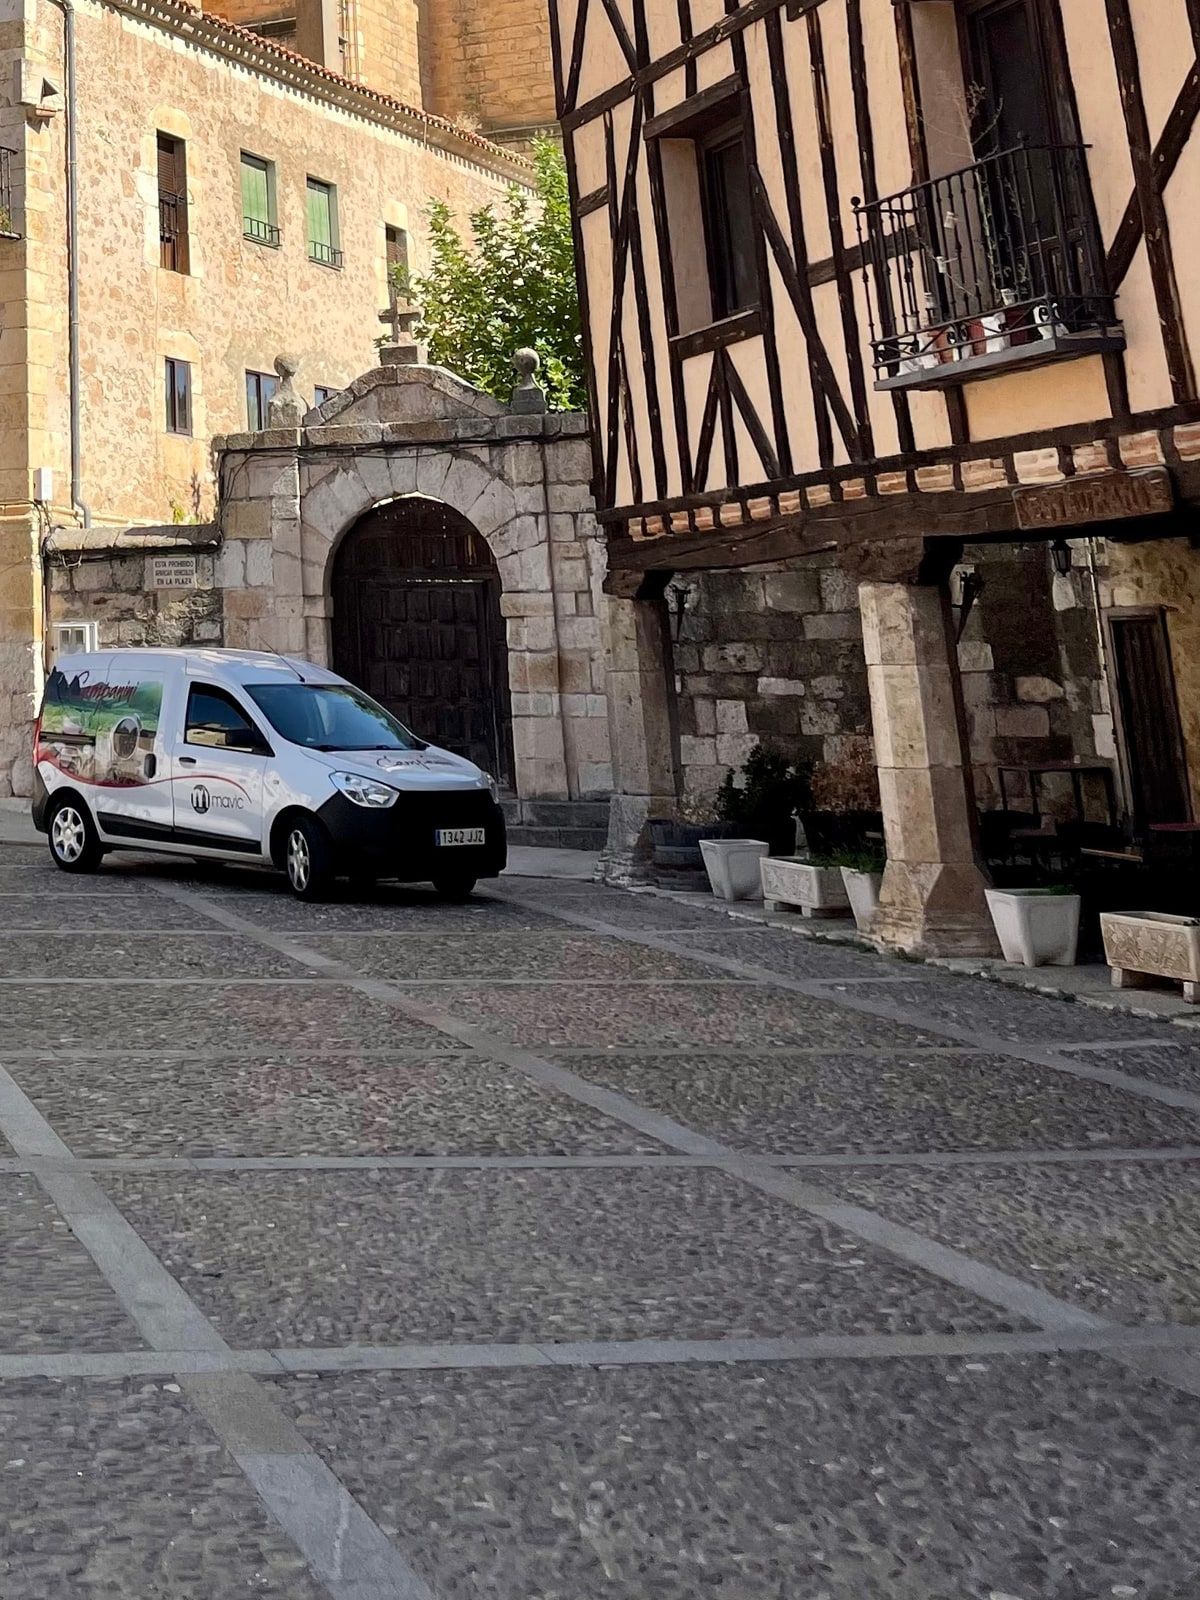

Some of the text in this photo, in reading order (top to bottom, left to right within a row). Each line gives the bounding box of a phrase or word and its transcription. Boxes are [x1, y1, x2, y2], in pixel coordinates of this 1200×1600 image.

[168, 560, 194, 568] PROHIBIDO
[175, 577, 192, 585] PLAZA
[211, 795, 244, 810] mavic
[443, 830, 484, 844] 1342 JJZ
